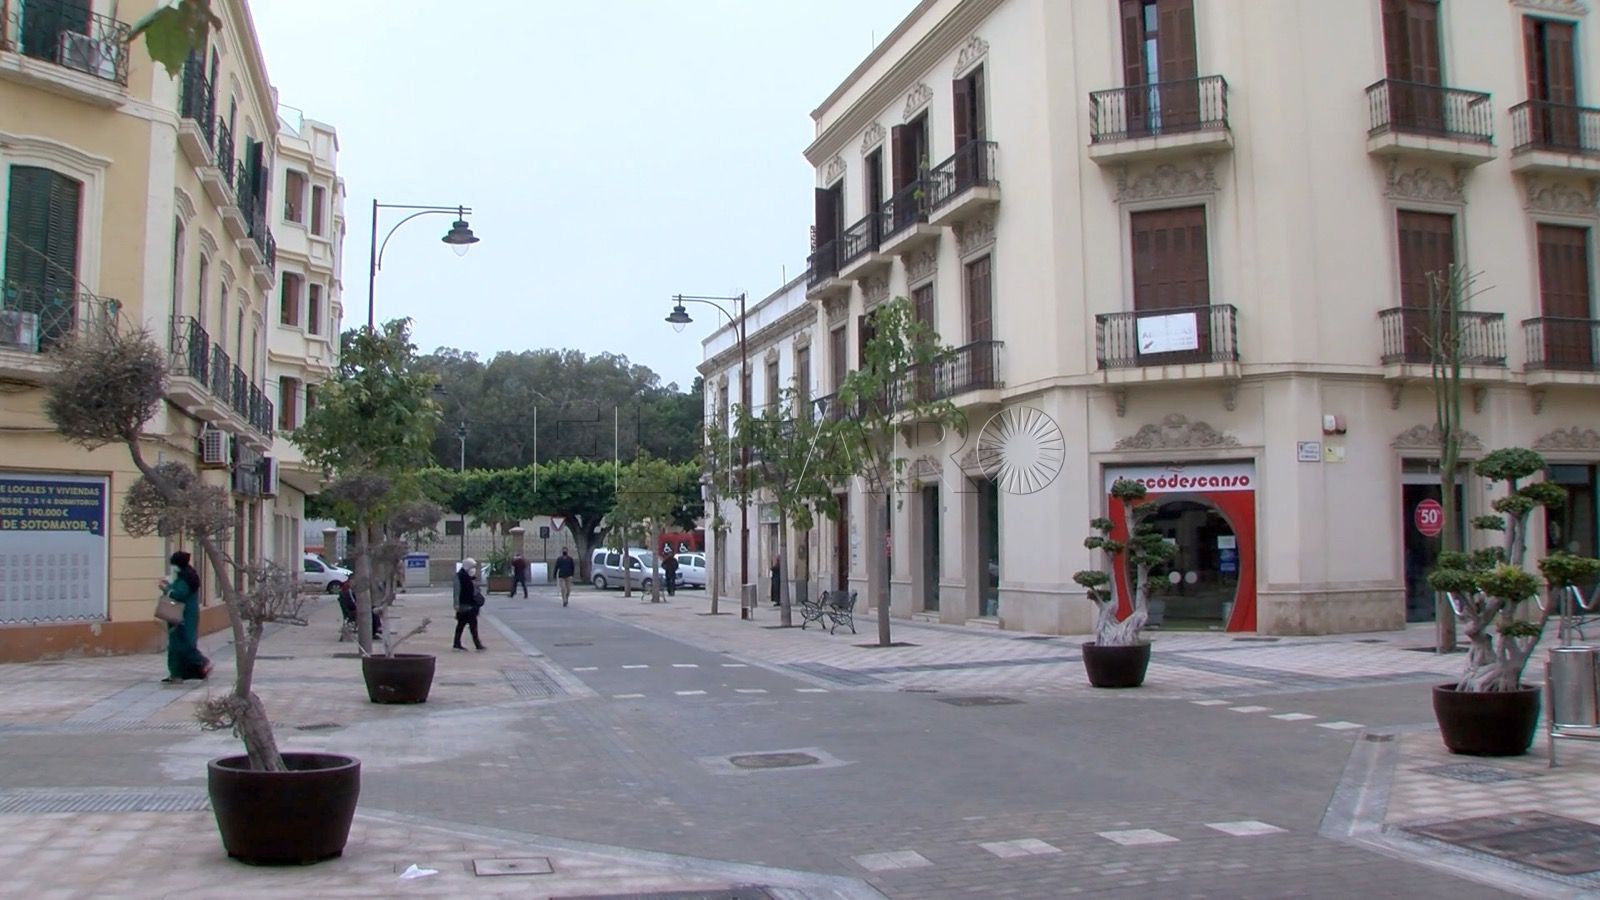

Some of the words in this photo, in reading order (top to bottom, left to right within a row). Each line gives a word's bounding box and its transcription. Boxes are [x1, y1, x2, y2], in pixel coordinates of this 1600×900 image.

[7, 486, 47, 495] LOCALES
[48, 487, 55, 495] Y
[56, 487, 100, 496] VIVIENDAS
[3, 520, 18, 529] DE
[91, 521, 99, 530] 2
